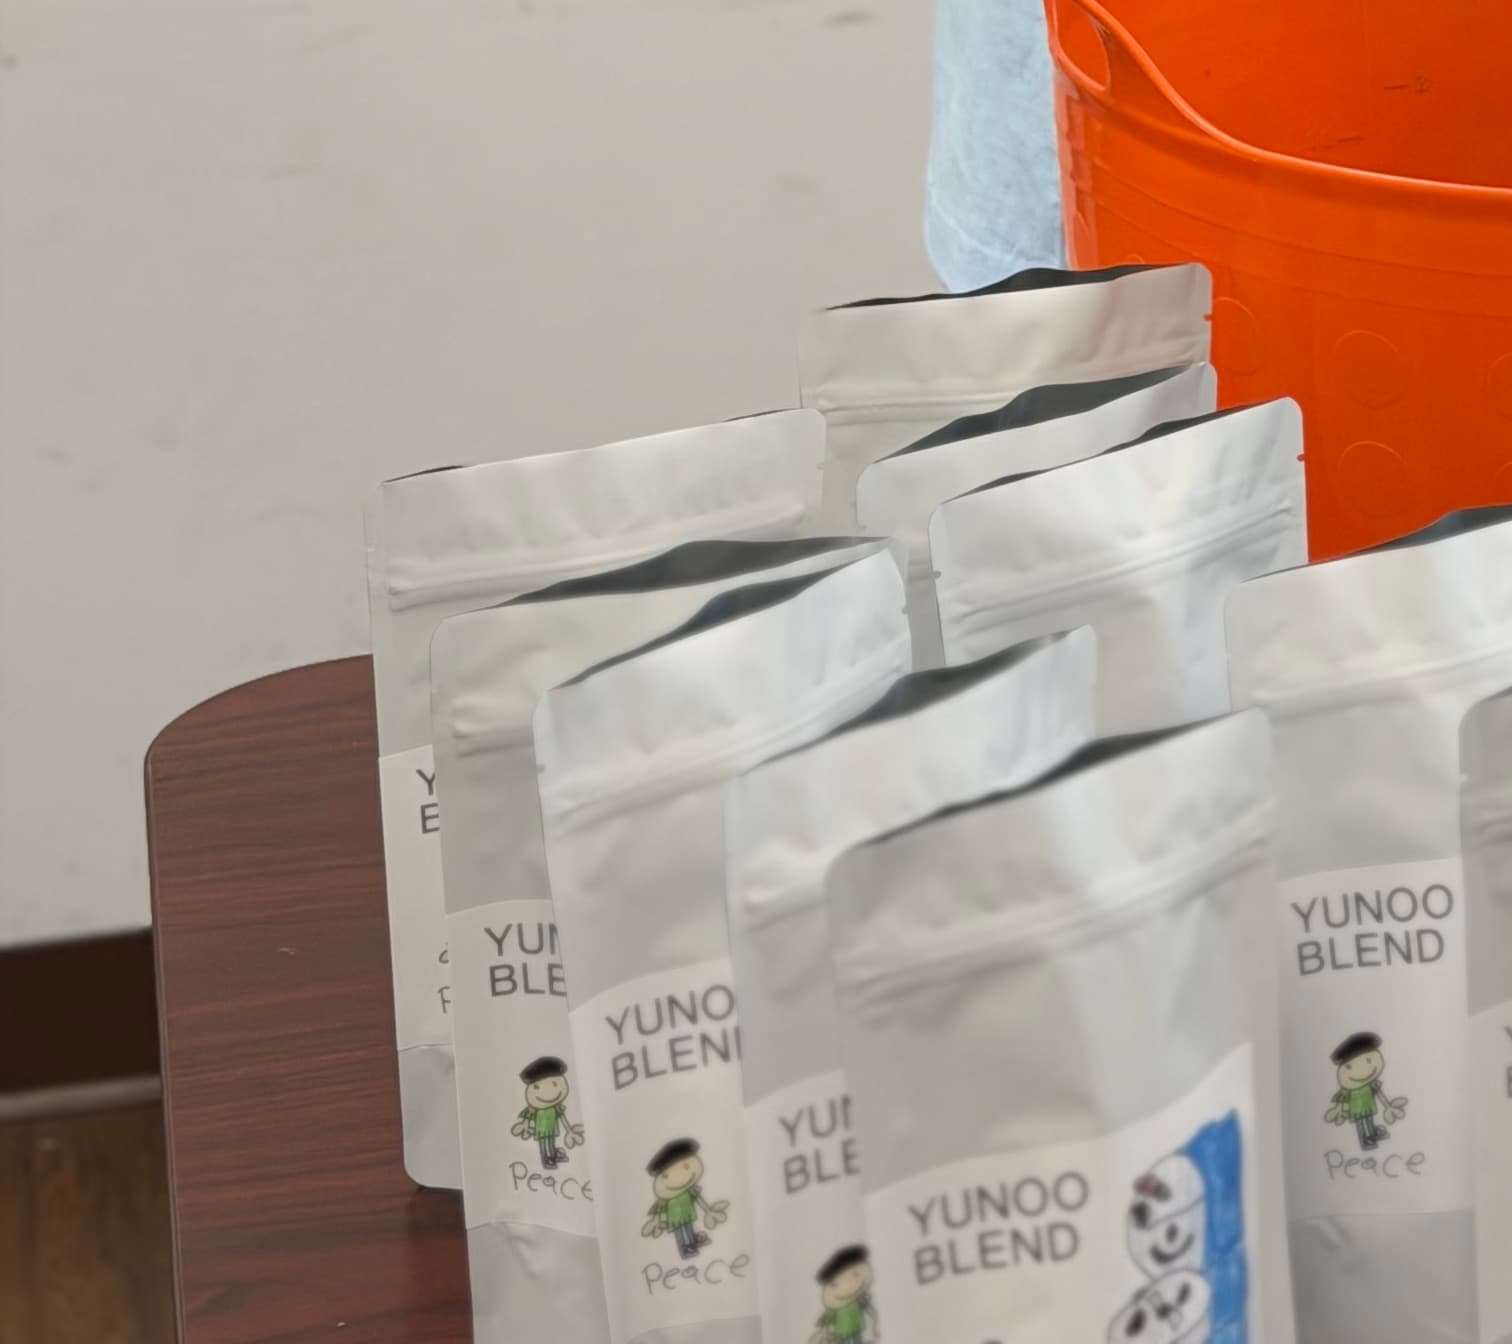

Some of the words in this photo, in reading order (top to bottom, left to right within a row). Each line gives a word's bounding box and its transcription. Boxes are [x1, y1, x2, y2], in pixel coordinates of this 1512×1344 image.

[1291, 884, 1454, 934] YUNOO
[1297, 928, 1444, 976] BLEND
[605, 984, 735, 1046] YUNO
[611, 1025, 742, 1090] BLEN
[1324, 1149, 1426, 1180] Peace
[907, 1170, 1090, 1237] YUNOO
[641, 1250, 750, 1295] Peace
[914, 1221, 1081, 1286] BLEND
